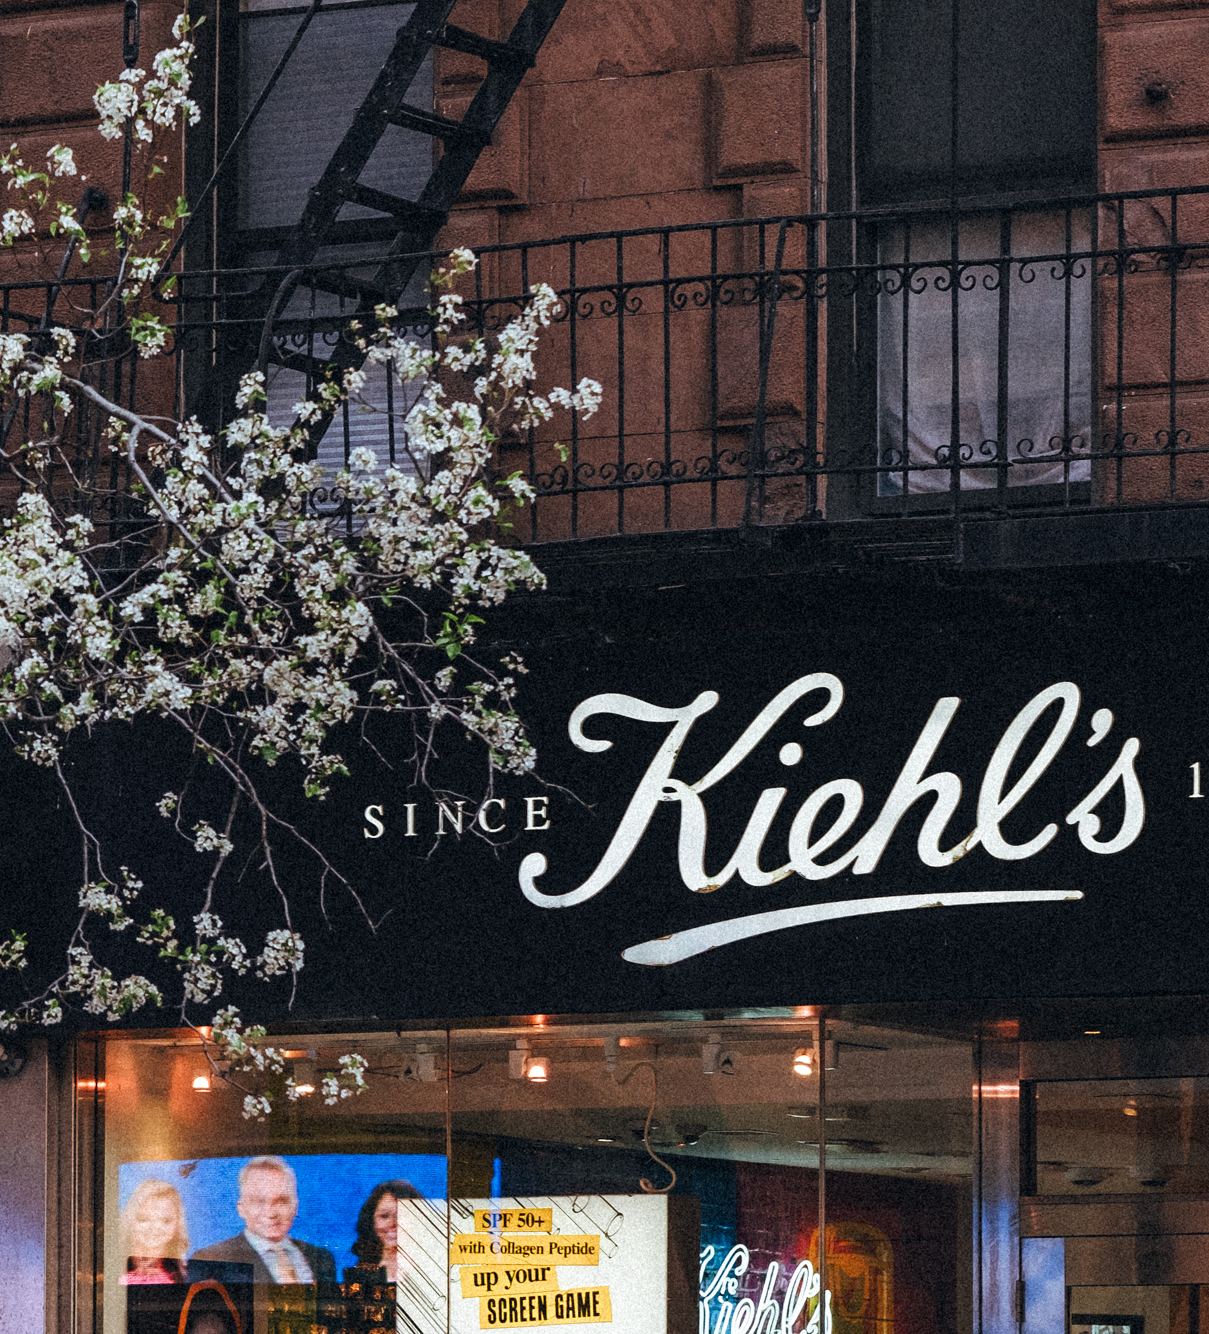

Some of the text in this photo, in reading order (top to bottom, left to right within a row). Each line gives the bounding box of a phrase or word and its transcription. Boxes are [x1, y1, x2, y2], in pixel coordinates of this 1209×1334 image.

[363, 796, 552, 839] SINCE
[518, 672, 1146, 910] Kiehl's
[482, 1212, 545, 1228] SPF 50+
[458, 1242, 595, 1259] with Collagen Peptide
[473, 1266, 551, 1291] up your
[487, 1291, 600, 1325] SCREEN GAME
